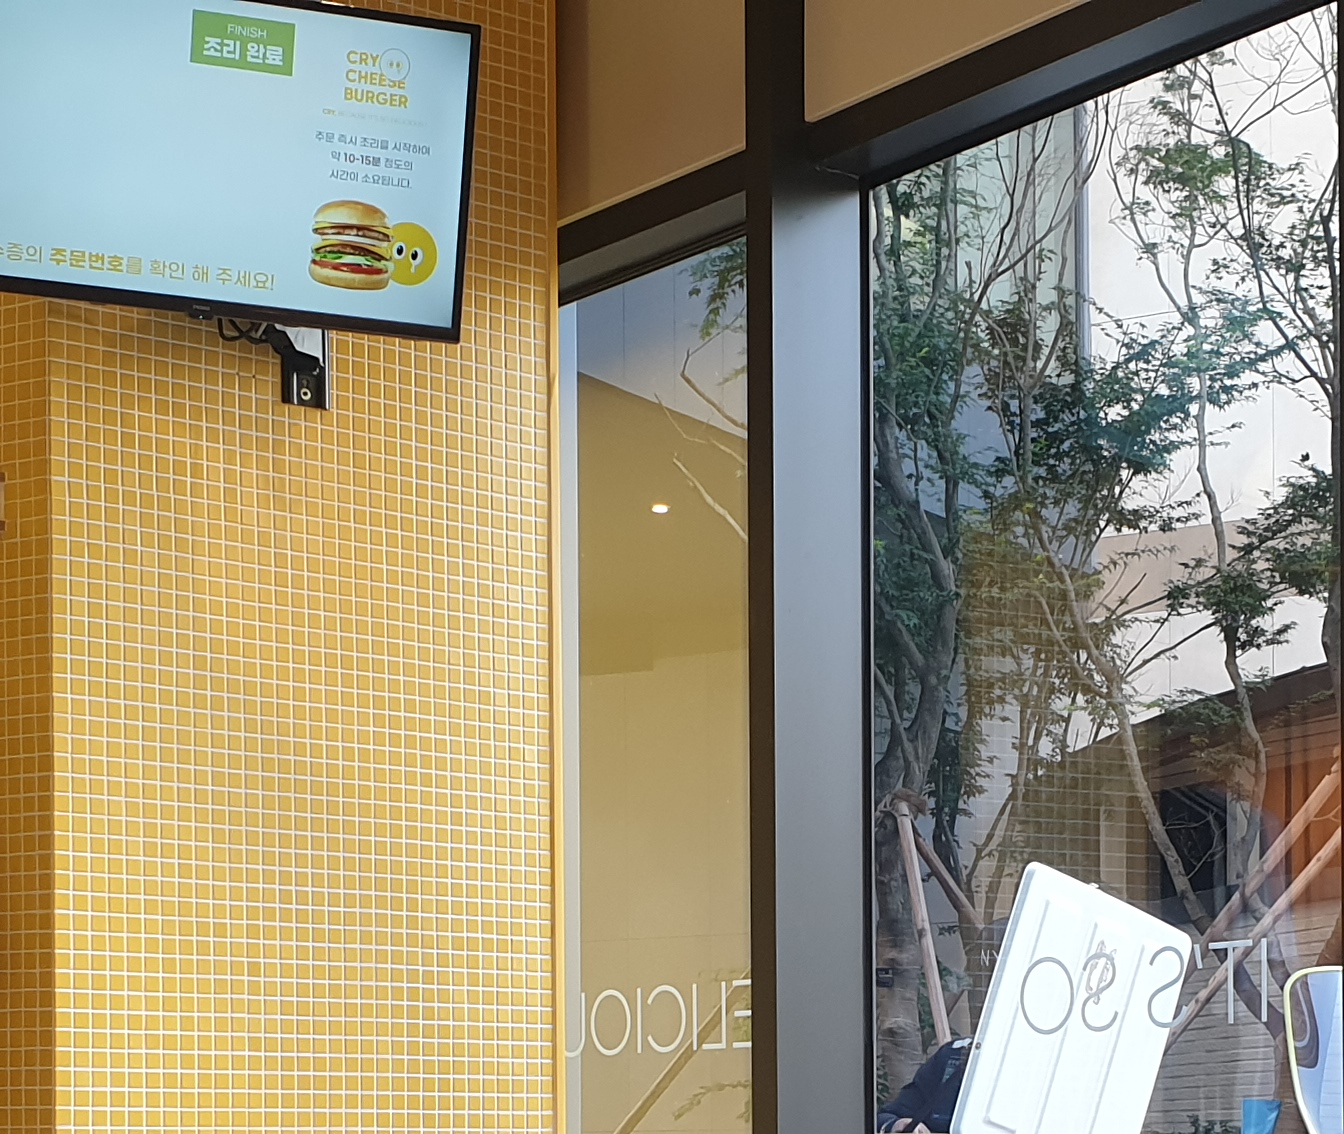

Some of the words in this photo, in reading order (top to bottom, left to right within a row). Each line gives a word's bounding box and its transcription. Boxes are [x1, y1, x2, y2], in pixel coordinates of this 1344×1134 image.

[227, 24, 267, 39] FINISH
[203, 36, 241, 60] 조리
[247, 42, 283, 66] 완료
[346, 50, 379, 67] CRY
[345, 69, 406, 90] CHEESE
[344, 86, 409, 109] BURGER
[315, 130, 335, 143] 주문
[337, 133, 357, 147] 즉시
[360, 136, 389, 151] 조리를
[392, 141, 431, 156] 시작하여
[331, 150, 341, 162] 약
[343, 151, 381, 167] 10-15분
[384, 157, 413, 171] 정도의
[329, 169, 358, 182] 시간이
[361, 173, 413, 189] 소요됩니다.
[49, 247, 143, 276] 주문번호를
[149, 258, 185, 281] 확인
[191, 263, 210, 283] 해
[215, 266, 275, 291] 주세요!
